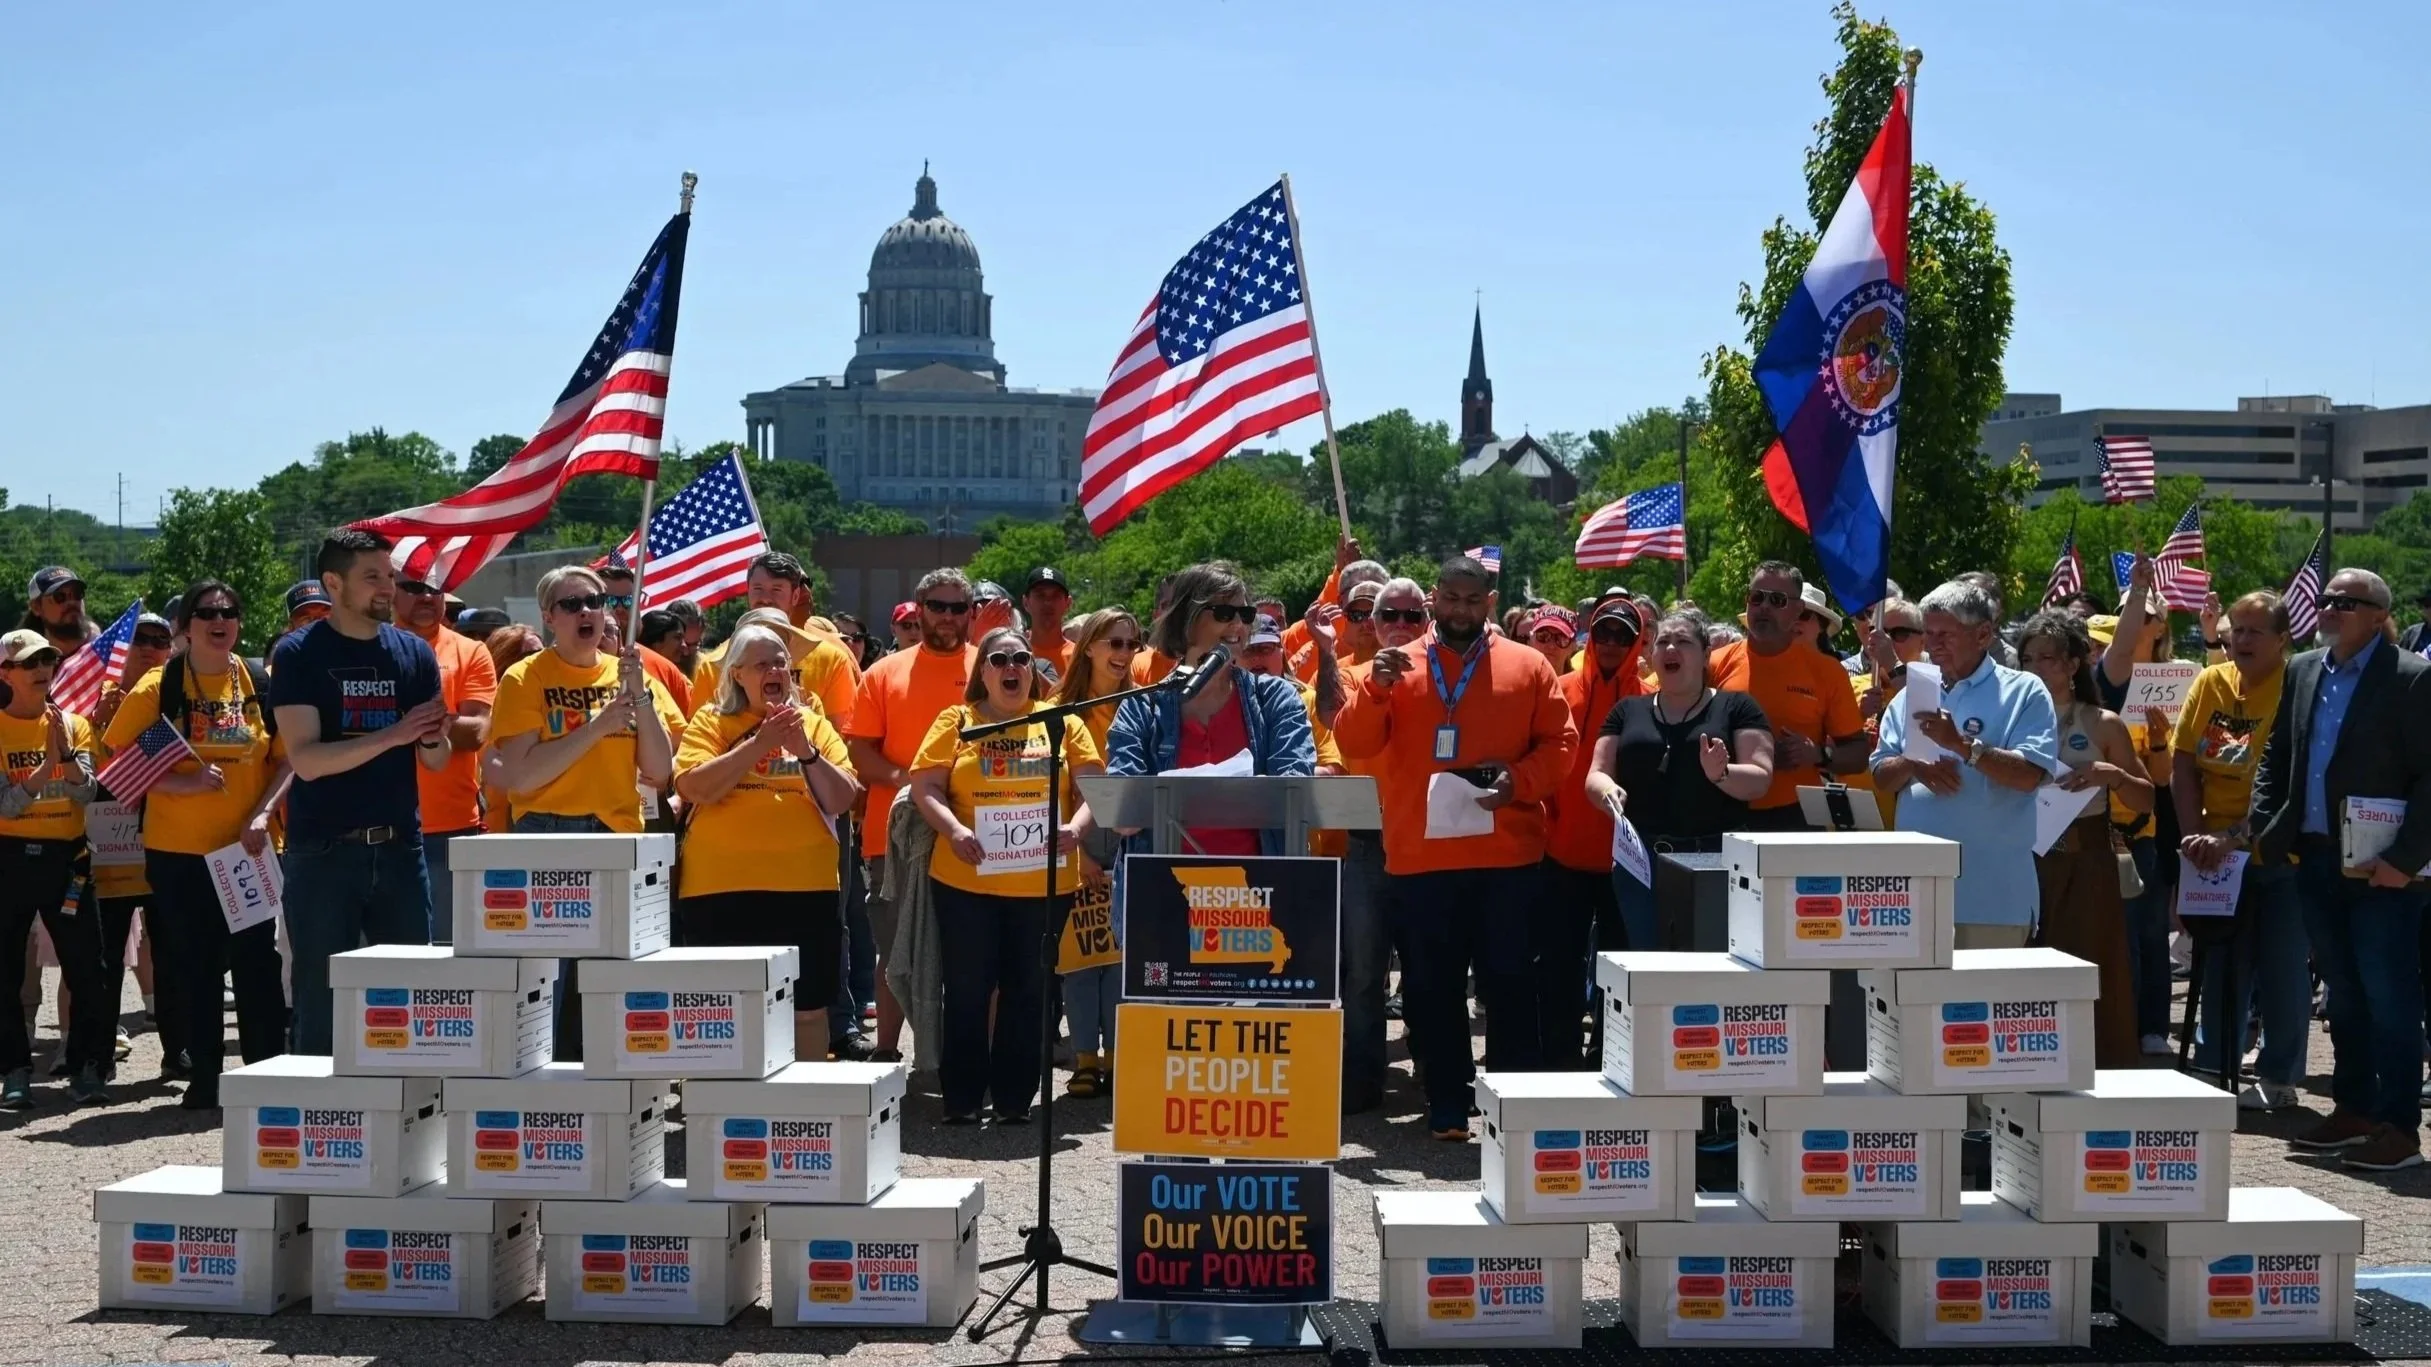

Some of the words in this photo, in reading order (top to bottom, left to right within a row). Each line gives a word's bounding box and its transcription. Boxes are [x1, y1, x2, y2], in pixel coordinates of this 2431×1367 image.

[2134, 668, 2193, 678] COLLECTED
[343, 680, 396, 696] RESPECT
[2141, 683, 2178, 702] 955
[7, 750, 46, 768] RESP
[985, 812, 987, 821] I
[2358, 810, 2404, 824] ATURES
[989, 822, 1043, 849] 409
[96, 843, 144, 853] SIGNATU
[987, 848, 1048, 861] SIGNATURE
[215, 860, 239, 914] COLLECTED
[233, 860, 261, 909] 1093
[531, 871, 592, 887] RESPECT
[1847, 876, 1911, 892] RESPECT
[531, 888, 590, 900] MISSOURI
[1189, 886, 1274, 909] RESPECT
[1847, 893, 1909, 906] MISSOURI
[2185, 892, 2231, 903] SIGNATURES
[532, 902, 591, 919] VOTERS
[1072, 907, 1111, 930] MIS
[1189, 909, 1270, 927] MISSOURI
[1848, 908, 1910, 927] VOTERS
[1189, 929, 1273, 952] VOTERS
[413, 989, 474, 1005] RESPECT
[673, 993, 733, 1008] RESPECT
[413, 1007, 472, 1018] MISSOURI
[673, 1009, 733, 1021] MISSOURI
[1724, 1004, 1786, 1022] RESPECT
[1993, 1001, 2057, 1018] RESPECT
[414, 1020, 473, 1037] VOTERS
[675, 1022, 734, 1040] VOTERS
[1724, 1022, 1786, 1036] MISSOURI
[1994, 1019, 2056, 1033] MISSOURI
[1166, 1019, 1222, 1053] LET
[1233, 1020, 1292, 1055] THE
[1995, 1034, 2058, 1052] VOTERS
[1725, 1037, 1788, 1056] VOTERS
[1165, 1057, 1290, 1095] PEOPLE
[304, 1111, 364, 1126] RESPECT
[523, 1113, 584, 1128] RESPECT
[1164, 1098, 1289, 1139] DECIDE
[304, 1127, 362, 1140] MISSOURI
[523, 1129, 582, 1141] MISSOURI
[771, 1121, 832, 1137] RESPECT
[771, 1139, 830, 1151] MISSOURI
[1585, 1130, 1650, 1146] RESPECT
[1853, 1132, 1917, 1148] RESPECT
[2136, 1131, 2197, 1147] RESPECT
[305, 1140, 363, 1158] VOTERS
[524, 1143, 583, 1160] VOTERS
[1586, 1147, 1648, 1160] MISSOURI
[1853, 1150, 1916, 1163] MISSOURI
[2135, 1148, 2196, 1161] MISSOURI
[772, 1153, 832, 1170] VOTERS
[1587, 1161, 1650, 1180] VOTERS
[1854, 1165, 1917, 1182] VOTERS
[2136, 1163, 2197, 1181] VOTERS
[1151, 1174, 1206, 1211] Our
[1217, 1176, 1300, 1211] VOTE
[180, 1226, 238, 1243] RESPECT
[1143, 1213, 1201, 1249] Our
[1211, 1215, 1308, 1251] VOICE
[392, 1233, 452, 1248] RESPECT
[630, 1236, 690, 1250] RESPECT
[179, 1243, 235, 1256] MISSOURI
[392, 1249, 450, 1262] MISSOURI
[857, 1243, 919, 1259] RESPECT
[180, 1257, 236, 1275] VOTERS
[630, 1252, 688, 1264] MISSOURI
[857, 1260, 917, 1272] MISSOURI
[1479, 1258, 1542, 1272] RESPECT
[1729, 1257, 1794, 1273] RESPECT
[2258, 1255, 2320, 1271] RESPECT
[392, 1262, 451, 1280] VOTERS
[631, 1265, 690, 1282] VOTERS
[1136, 1252, 1191, 1286] Our
[1202, 1253, 1316, 1286] POWER
[1987, 1260, 2051, 1276] RESPECT
[858, 1274, 918, 1292] VOTERS
[1479, 1272, 1542, 1285] MISSOURI
[1729, 1274, 1792, 1287] MISSOURI
[1987, 1277, 2049, 1290] MISSOURI
[2258, 1273, 2319, 1286] MISSOURI
[1481, 1286, 1544, 1305] VOTERS
[1731, 1288, 1794, 1306] VOTERS
[1988, 1291, 2050, 1310] VOTERS
[2259, 1287, 2320, 1305] VOTERS
